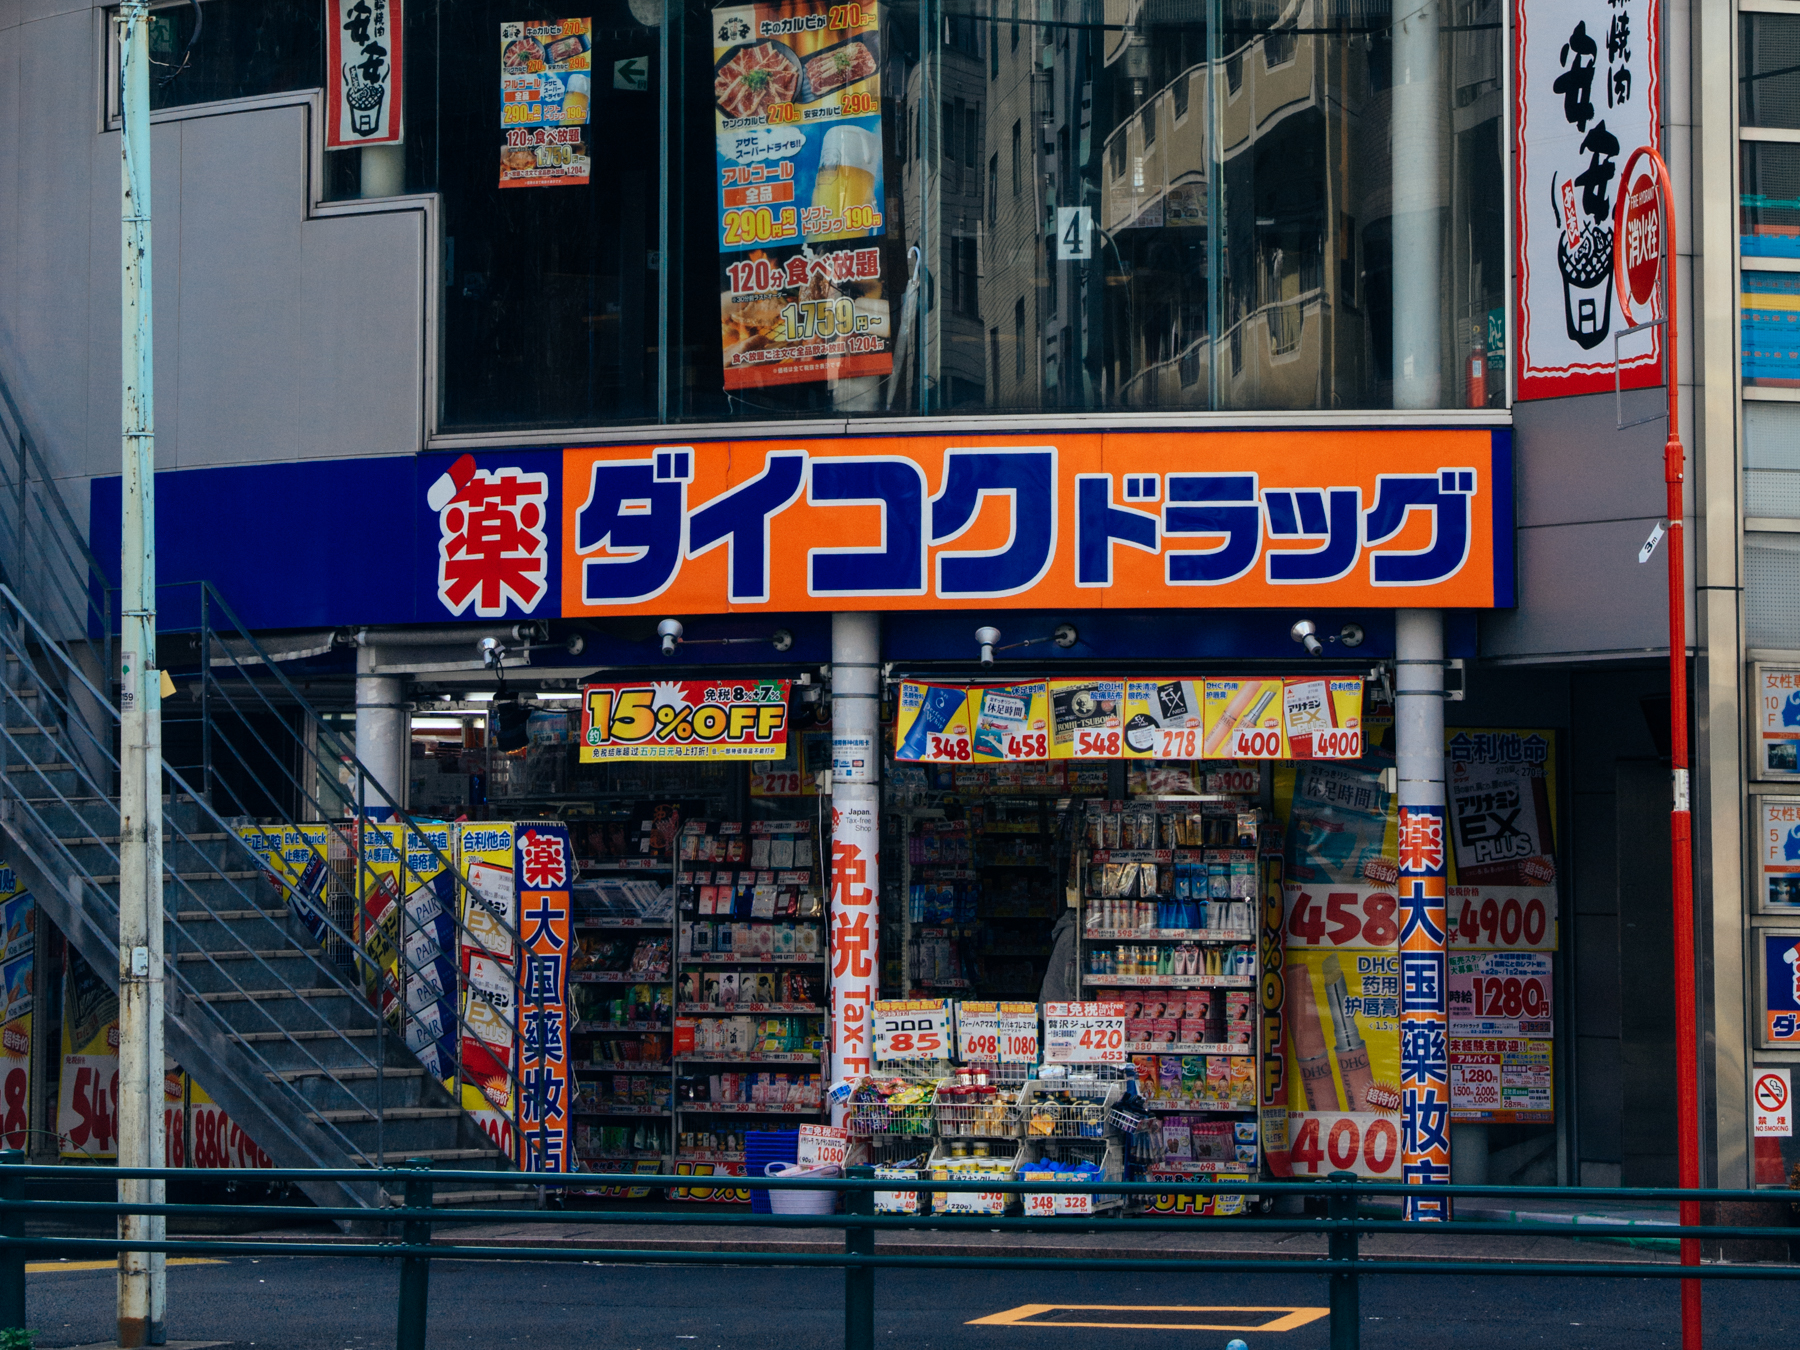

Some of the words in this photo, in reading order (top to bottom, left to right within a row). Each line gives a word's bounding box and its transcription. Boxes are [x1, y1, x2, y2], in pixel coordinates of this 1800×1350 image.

[761, 16, 826, 35] 牛のカルビが
[504, 79, 541, 90] アルコール
[515, 91, 529, 101] 全品
[804, 106, 840, 119] 安安カルビ
[842, 93, 877, 113] 290円
[722, 116, 765, 128] ヤングカルビ
[768, 103, 800, 124] 270円
[736, 137, 758, 148] アサヒ
[736, 140, 801, 159] スーパードライも!!
[722, 161, 794, 185] アルコール
[746, 186, 772, 202] 全品
[801, 207, 831, 220] ソフト
[802, 221, 842, 235] ドリンク
[843, 206, 882, 229] 190円
[1063, 211, 1083, 254] 4
[1628, 209, 1658, 269] 消火栓
[733, 343, 845, 363] 食べ放題ご注文で全品飲み放題
[440, 468, 548, 617] 薬
[1098, 683, 1123, 691] ROIHI
[1330, 683, 1361, 691] 合利他命
[1090, 692, 1123, 700] 酸痛贴布
[1765, 697, 1779, 709] 10
[986, 703, 1023, 717] 休足時間
[1288, 700, 1320, 712] アリナミン
[588, 689, 786, 744] 15%OFF
[1289, 709, 1322, 726] EX
[1768, 714, 1776, 726] F
[588, 728, 600, 743] 约
[1450, 733, 1547, 762] 合利他命
[1307, 777, 1371, 809] 休足時間
[1456, 791, 1519, 815] アリナミン
[848, 808, 871, 816] Japan.
[845, 817, 871, 825] Tax-free
[1459, 809, 1521, 846] EX
[855, 825, 871, 833] Shop
[1770, 829, 1778, 841] 5
[285, 833, 299, 845] EVE
[463, 831, 511, 850] 合利他命
[1475, 833, 1532, 862] PLUS
[1771, 847, 1778, 859] F
[284, 849, 309, 862] 止疼药
[522, 834, 567, 887] 薬
[1365, 861, 1398, 882] 超特价
[1525, 863, 1553, 880] 超特价
[1448, 887, 1479, 896] 免税价格
[831, 839, 872, 978] 免税
[1289, 892, 1398, 947] 458
[1358, 957, 1398, 973] DHC
[1449, 954, 1486, 965] 販売スタッフ
[1363, 977, 1397, 994] 药用
[1450, 991, 1472, 1003] 時給
[1473, 977, 1550, 1017] 1280円
[468, 1001, 507, 1023] EX
[750, 1003, 763, 1011] 880
[1069, 1002, 1098, 1016] 免税
[1345, 997, 1398, 1017] 护唇膏
[886, 1019, 932, 1031] コロロ
[1049, 1020, 1123, 1029] 贅沢ジュレマスク
[3, 1028, 29, 1055] 超特价
[1450, 1039, 1526, 1052] 未経験者歓迎!!
[1340, 1055, 1367, 1070] DHC
[1458, 1055, 1495, 1063] アルバイト
[1303, 1064, 1329, 1079] DHC
[1366, 1088, 1400, 1109] 超特价
[0, 1068, 26, 1150] 8
[737, 1103, 749, 1111] 580
[782, 1104, 795, 1112] 498
[813, 1127, 831, 1137] 免税
[1291, 1118, 1397, 1174] 400
[817, 1147, 843, 1162] 1080
[1065, 1197, 1087, 1208] 328
